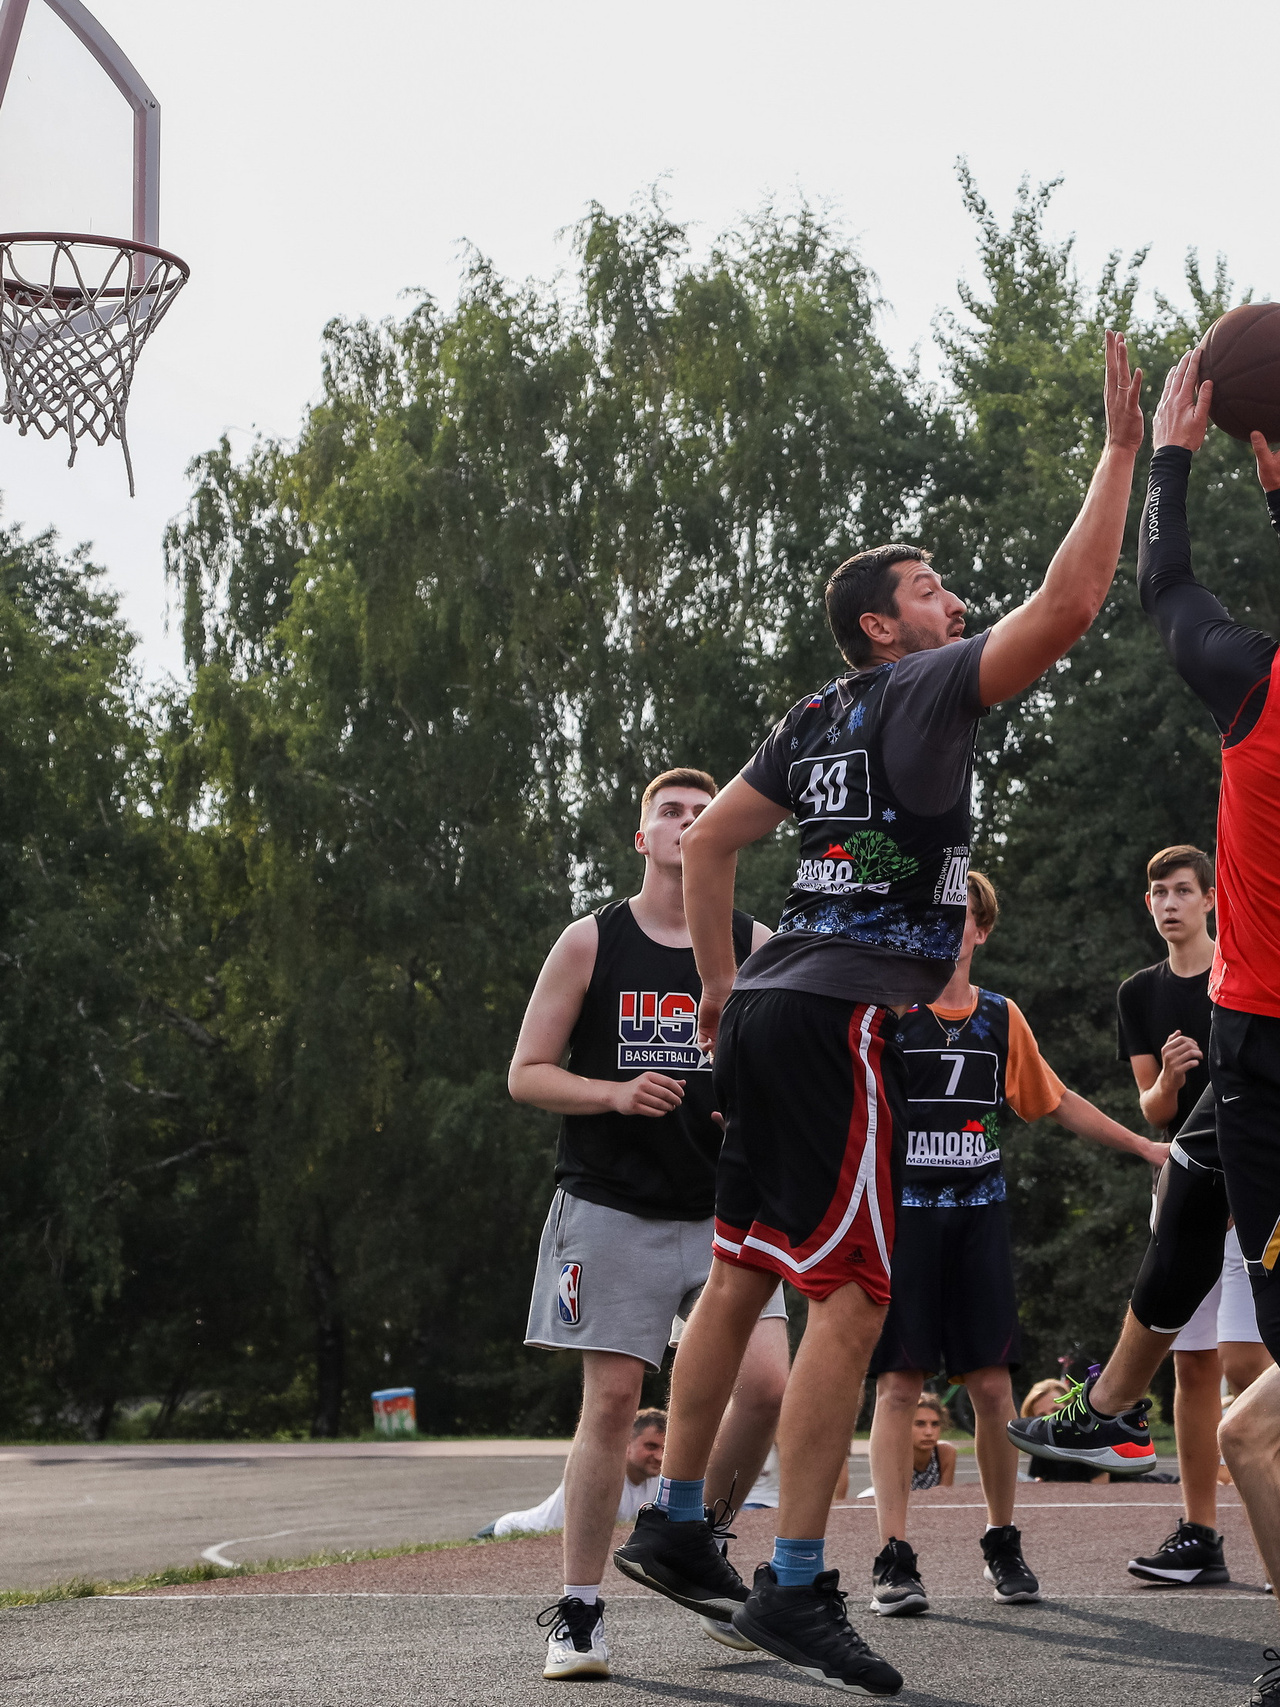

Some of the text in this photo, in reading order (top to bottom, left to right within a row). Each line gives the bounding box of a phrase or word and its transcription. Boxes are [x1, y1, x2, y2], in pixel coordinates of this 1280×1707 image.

[1148, 486, 1162, 544] OUTSHOCK
[799, 760, 848, 814] 40
[618, 991, 698, 1044] US
[624, 1050, 697, 1064] BASKETBALL
[940, 1054, 966, 1096] 7
[907, 1157, 971, 1166] маленькая
